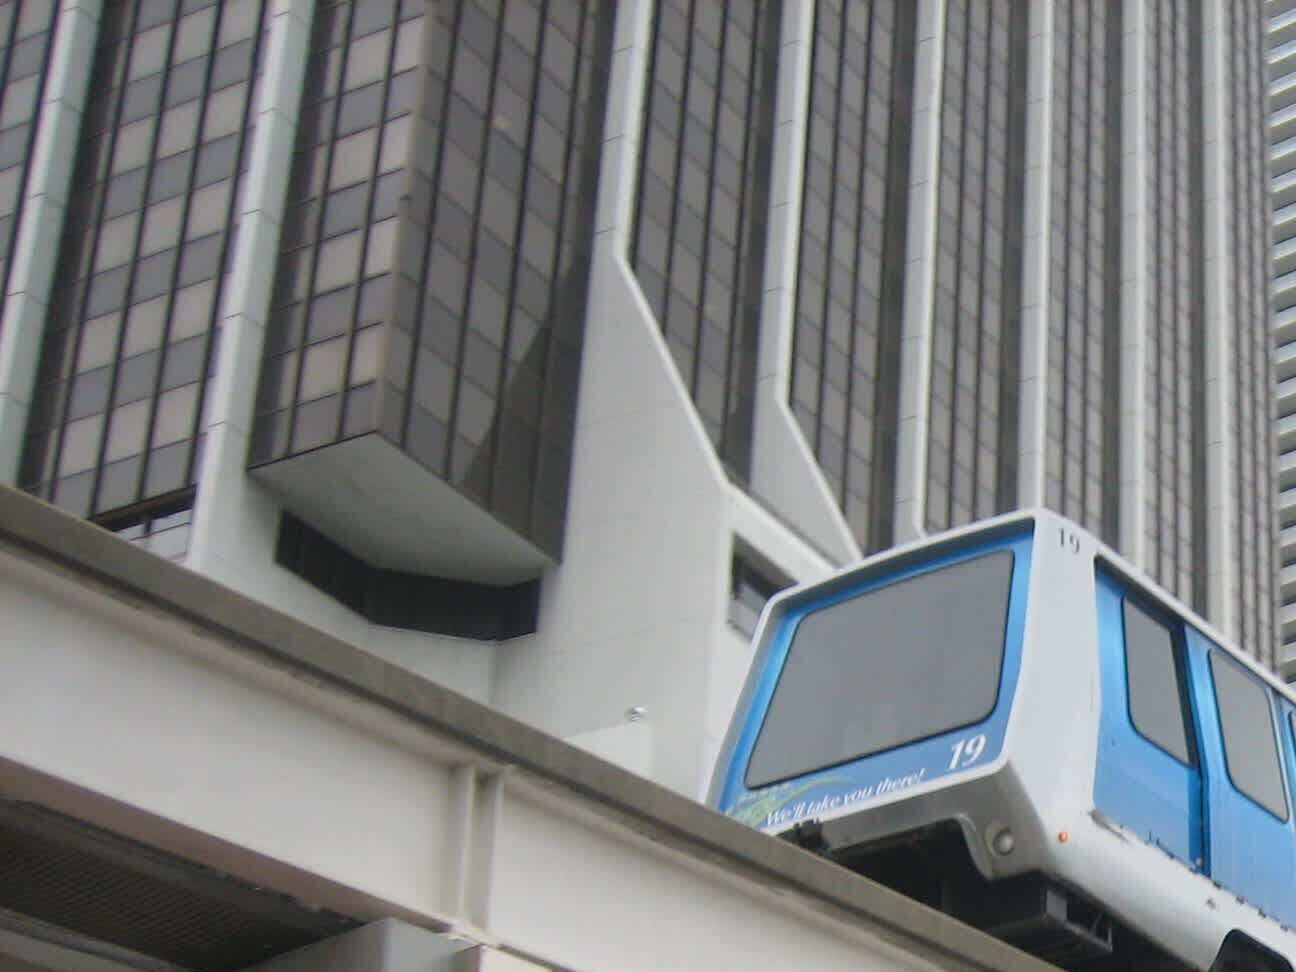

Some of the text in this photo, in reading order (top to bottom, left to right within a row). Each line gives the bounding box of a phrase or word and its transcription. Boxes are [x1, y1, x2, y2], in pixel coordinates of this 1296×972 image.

[1059, 528, 1080, 553] 19
[949, 734, 986, 769] 19
[766, 801, 807, 825] We'll
[807, 796, 841, 817] take
[844, 786, 872, 806] you
[876, 767, 925, 795] there!
